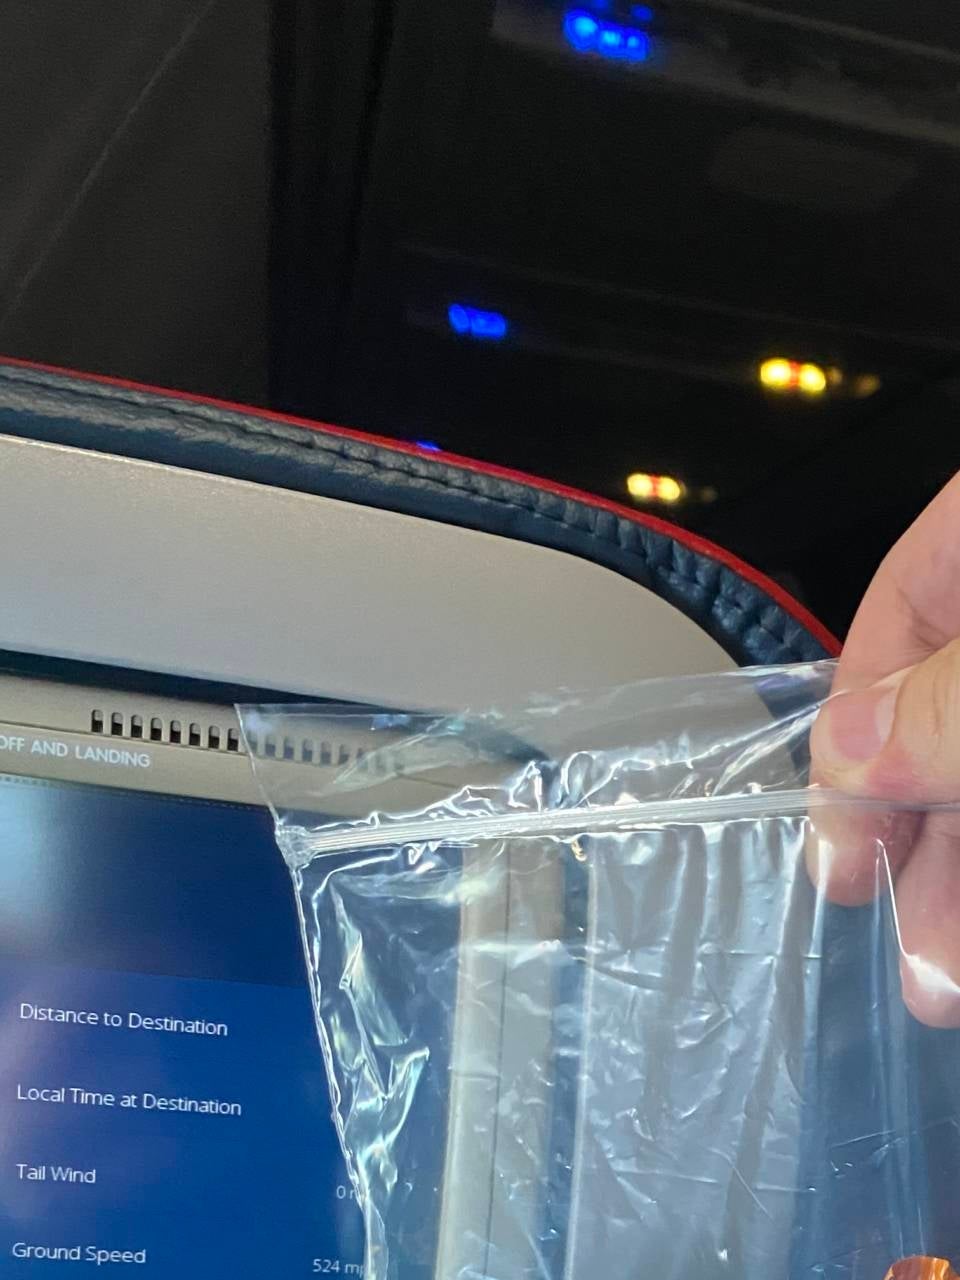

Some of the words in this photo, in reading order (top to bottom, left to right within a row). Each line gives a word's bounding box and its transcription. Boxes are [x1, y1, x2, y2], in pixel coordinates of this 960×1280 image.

[31, 740, 68, 757] AND
[75, 745, 150, 768] LANDING
[19, 1002, 98, 1025] Distance
[104, 1011, 122, 1027] to
[128, 1012, 228, 1036] Destination
[17, 1084, 65, 1102] Local
[69, 1087, 115, 1106] Time
[120, 1094, 137, 1108] at
[143, 1093, 242, 1116] Destination
[16, 1163, 46, 1181] Tail
[50, 1166, 97, 1184] Wind
[12, 1242, 81, 1260] Ground
[85, 1246, 147, 1266] Speed
[312, 1258, 341, 1273] 524
